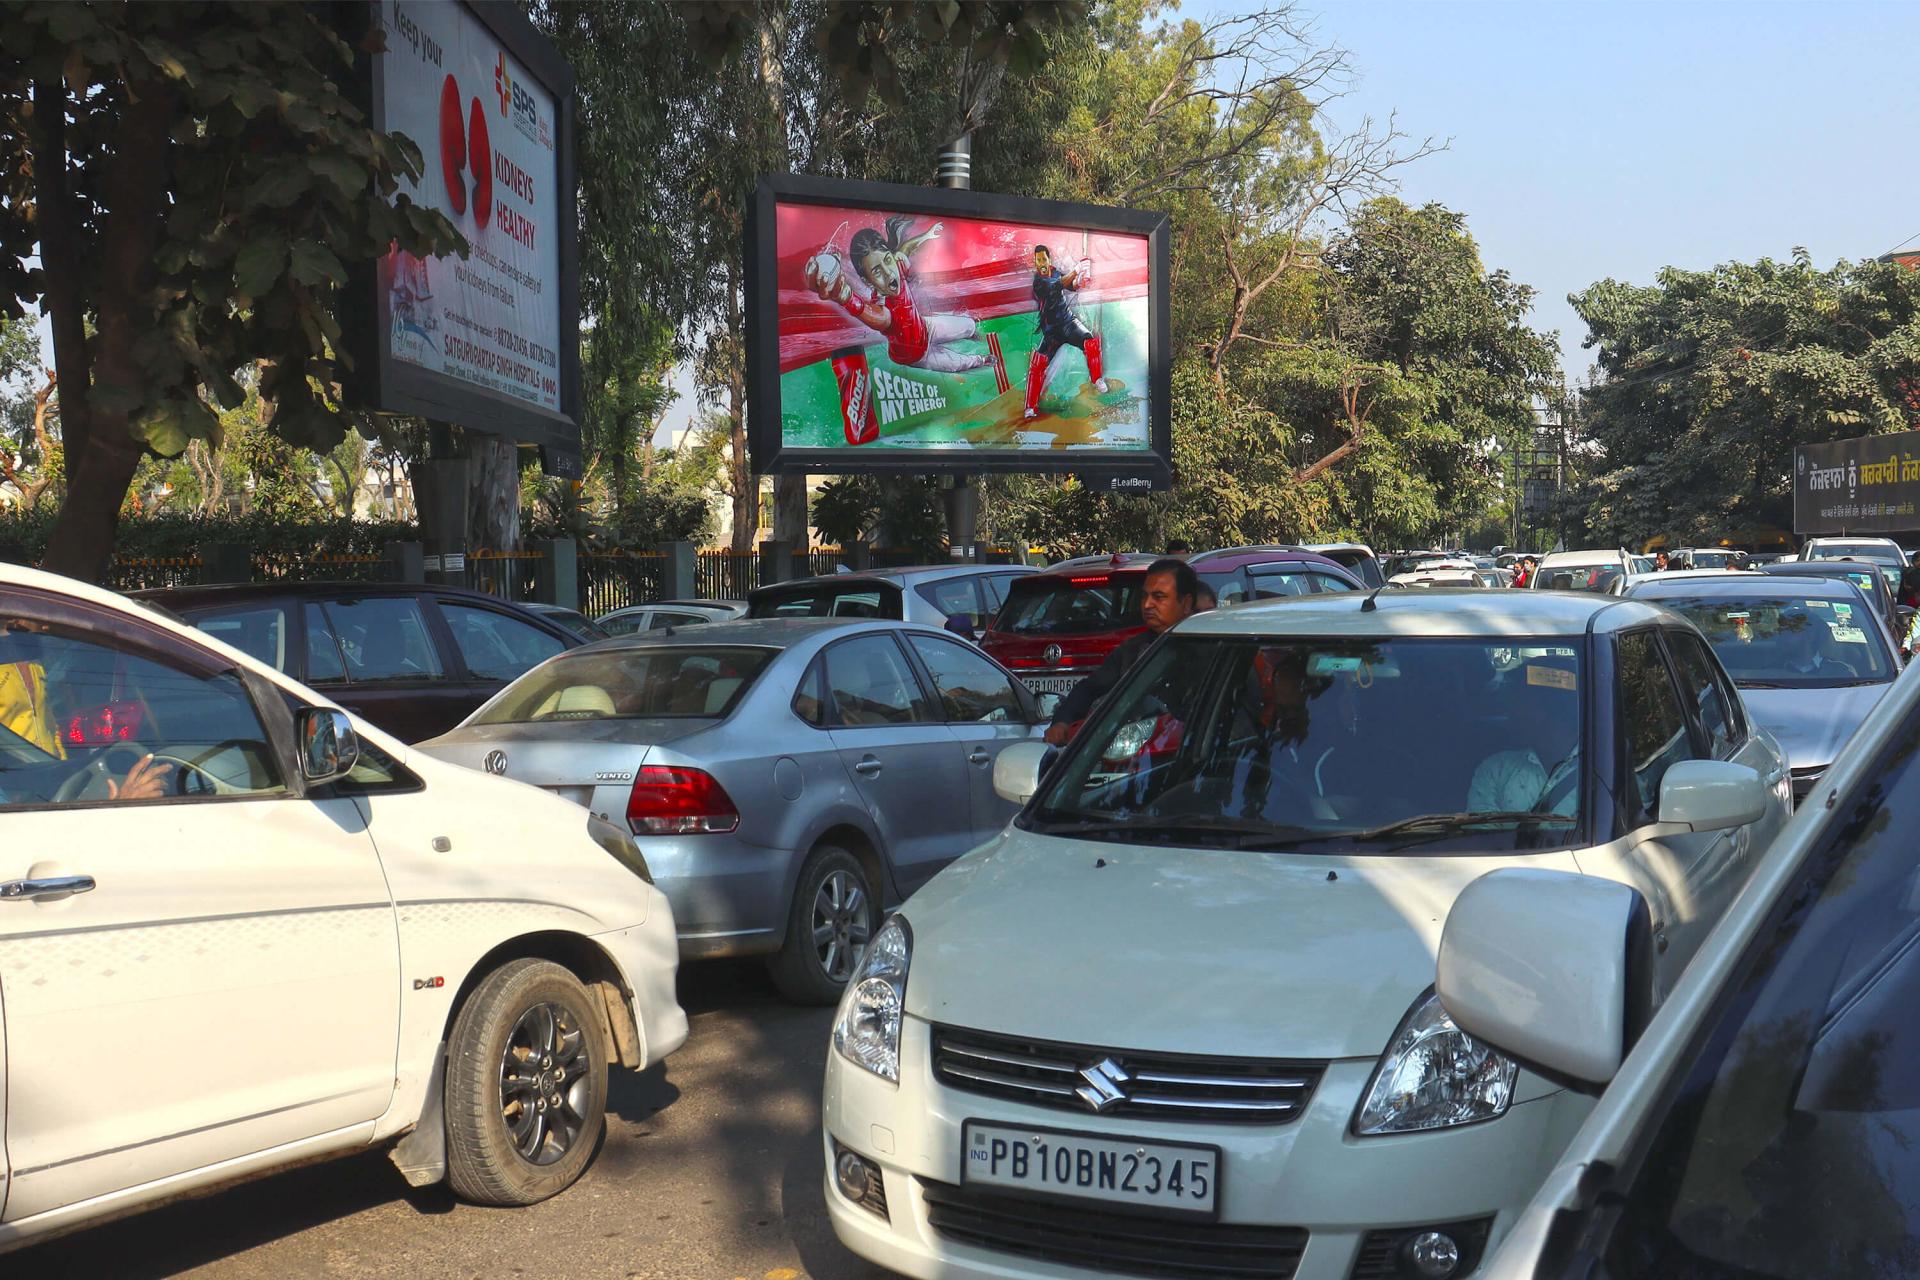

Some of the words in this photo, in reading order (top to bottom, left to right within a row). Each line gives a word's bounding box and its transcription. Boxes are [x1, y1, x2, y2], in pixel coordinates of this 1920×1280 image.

[393, 2, 419, 54] Keep
[421, 32, 443, 68] your
[512, 81, 537, 125] SPS
[494, 149, 534, 206] KIDNEYS
[496, 199, 536, 251] HEALTHY
[444, 334, 473, 364] SATGURU
[473, 345, 496, 372] PARTAP
[496, 355, 513, 380] SINGH
[513, 361, 540, 389] HOSPITALS
[873, 367, 925, 400] SECRET
[926, 384, 939, 399] OF
[880, 398, 905, 425] MY
[908, 395, 947, 416] ENERGY
[1117, 477, 1152, 489] LeafBerry
[1809, 461, 1845, 491] ਨੌਜਵਾਨਾਂ
[1848, 459, 1857, 499] ਨੂੰ
[1860, 454, 1899, 486] ਸਰਕਾਰੀ
[595, 772, 632, 781] VENTO
[970, 1149, 989, 1161] IND
[990, 1138, 1209, 1200] PB10BN2345
